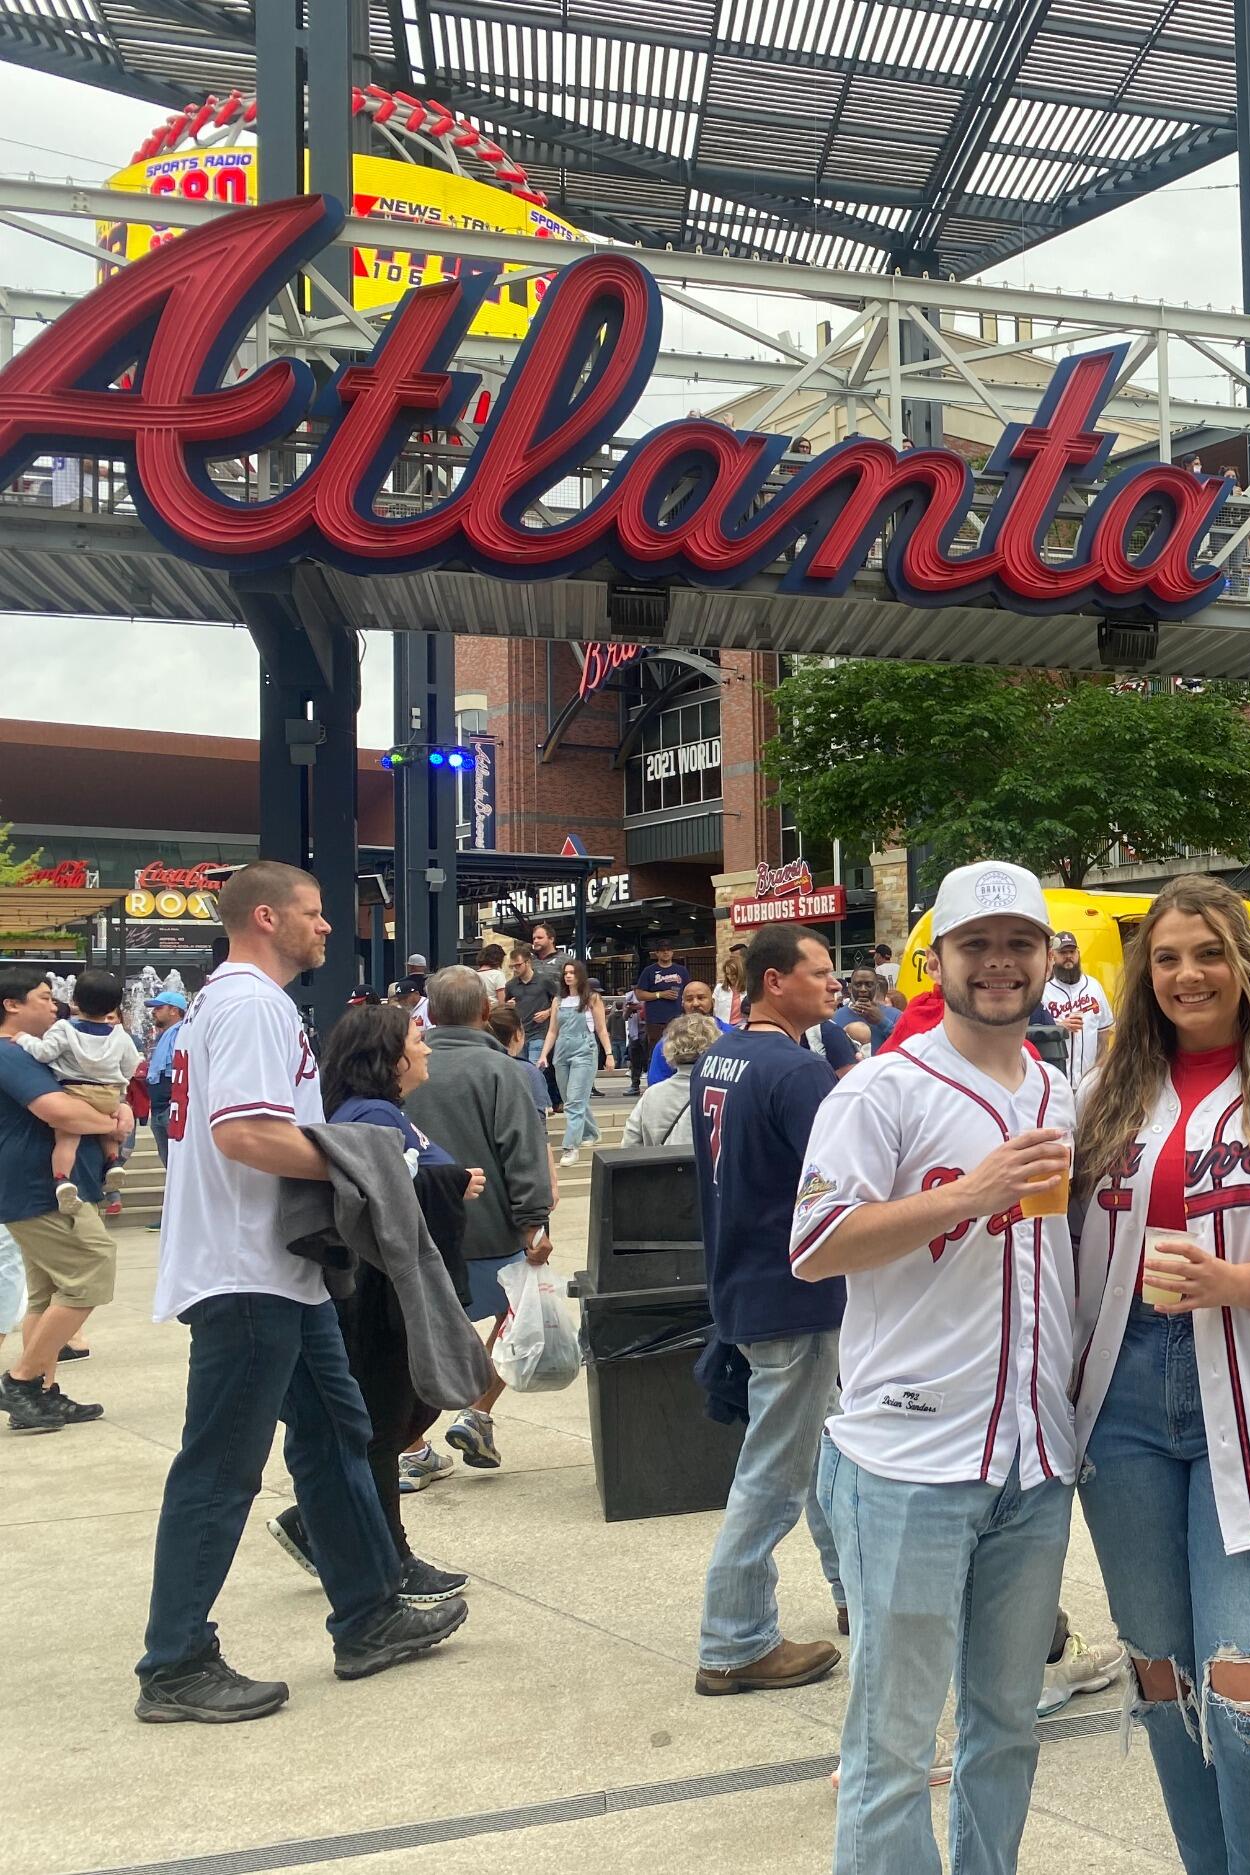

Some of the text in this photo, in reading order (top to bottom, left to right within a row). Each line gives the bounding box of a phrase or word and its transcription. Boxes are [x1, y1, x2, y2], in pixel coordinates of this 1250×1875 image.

[146, 154, 252, 176] SPORTS RADIO
[380, 197, 505, 232] NEWS TAK
[530, 210, 573, 241] SPORTS
[0, 192, 1228, 619] Atlanta
[646, 740, 721, 781] 2021 WORLD
[755, 857, 802, 899] Braves
[733, 894, 836, 924] CLUBHOUSE STORE
[700, 1055, 751, 1083] RAYRAY
[703, 1085, 728, 1185] 7
